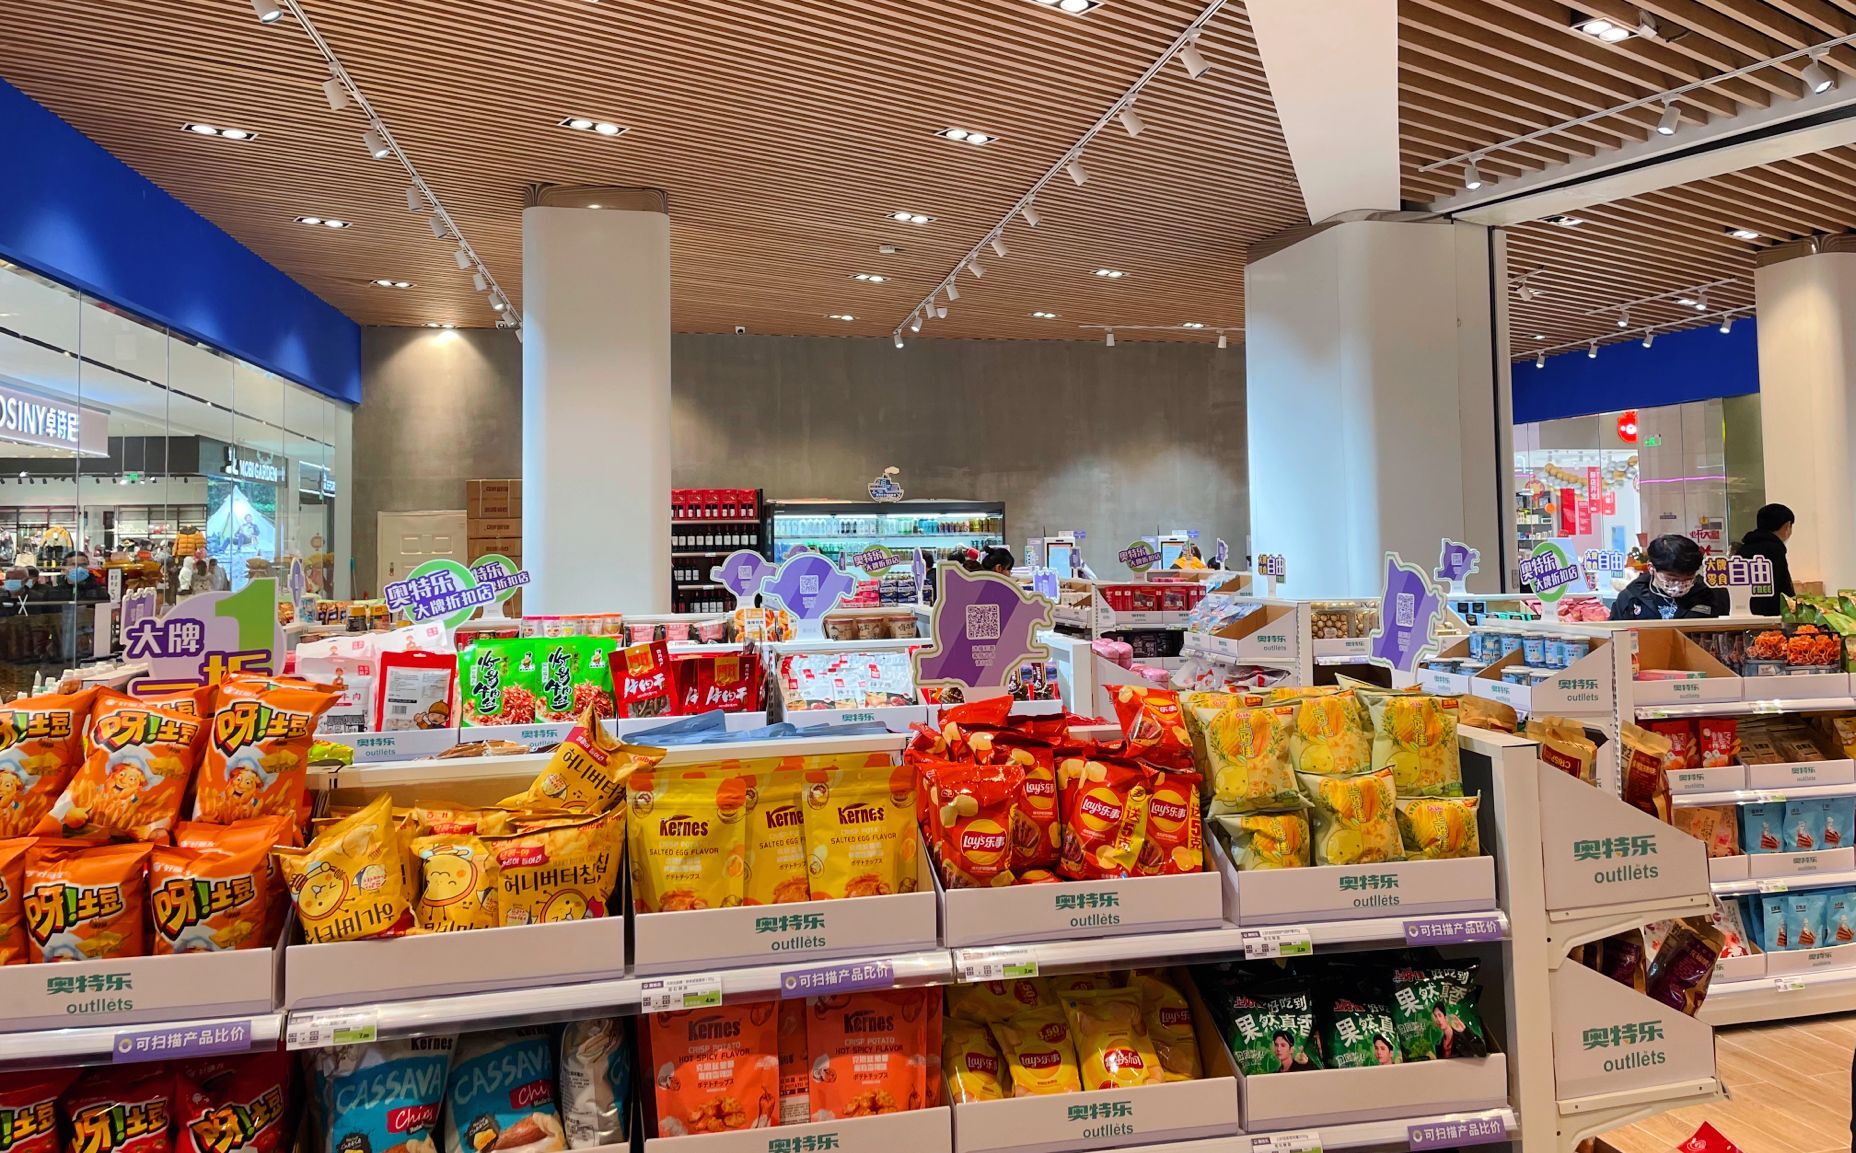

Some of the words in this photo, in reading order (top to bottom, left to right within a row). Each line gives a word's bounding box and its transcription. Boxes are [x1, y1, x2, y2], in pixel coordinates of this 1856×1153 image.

[854, 549, 884, 567] 奥特乐
[1119, 546, 1147, 562] 奥特乐
[1598, 551, 1623, 571] 自由
[472, 562, 504, 582] 特乐
[1521, 551, 1557, 582] 奥特乐
[1706, 559, 1727, 571] 大牌
[1728, 557, 1772, 585] 自由
[387, 570, 456, 607] 奥特乐
[1535, 566, 1578, 592] 大牌折扣店
[1707, 573, 1728, 586] 零食
[1753, 585, 1772, 594] FREE
[414, 584, 494, 621] 大牌折扣店
[131, 622, 200, 655] 大牌
[1257, 635, 1287, 643] 奥特乐
[1557, 679, 1599, 690] 奥特乐
[842, 712, 875, 722] 奥特乐
[97, 709, 200, 752] 呀!土豆
[213, 700, 313, 757] 呀!土豆
[522, 729, 558, 740] 奥特乐
[356, 738, 396, 748] 奥特乐
[765, 805, 805, 829] Kerne
[837, 803, 886, 825] Kernes
[660, 815, 709, 837] Kernes
[759, 839, 784, 850] SALTED
[785, 838, 799, 846] EGG
[830, 836, 856, 845] SALTED
[857, 834, 871, 842] EGG
[871, 832, 897, 842] FLAVOR
[1574, 835, 1659, 862] 奥特乐
[649, 848, 674, 856] SALTED
[690, 847, 720, 856] FLAVOR
[778, 861, 807, 871] ポテトチップ
[503, 863, 599, 896] 허니버터칩
[1339, 874, 1400, 891] 奥特乐
[152, 876, 256, 942] 呀!土豆
[1055, 892, 1120, 911] 奥特乐
[22, 879, 124, 947] 呀!土豆
[756, 912, 826, 934] 奥特乐
[1419, 920, 1497, 937] 可扫描产品比价
[46, 971, 133, 996] 奥特乐
[798, 966, 892, 988] 可扫描产品比价
[1394, 981, 1468, 1018] 果然真香
[688, 1017, 741, 1041] Kernes
[843, 1011, 894, 1034] Kernes
[1234, 1013, 1313, 1045] 果然真香
[1335, 1013, 1396, 1048] 果然真
[136, 1027, 246, 1052] 可扫描产品比价
[410, 1037, 453, 1051] Kernes
[844, 1038, 865, 1047] CRISP
[867, 1036, 895, 1045] POTATO
[1582, 1020, 1665, 1050] 奥特乐
[679, 1055, 694, 1063] HOT
[696, 1053, 718, 1062] SPICY
[721, 1048, 751, 1060] FLAVOR
[688, 1045, 711, 1054] CRISP
[712, 1041, 741, 1050] POTATO
[835, 1047, 850, 1055] HOT
[852, 1045, 873, 1054] SPICY
[875, 1044, 904, 1053] FLAVOR
[335, 1063, 441, 1115] CASSAVA
[517, 1079, 549, 1106] Chi
[1067, 1101, 1133, 1122] 奥特乐
[768, 1133, 840, 1153] 奥特乐
[1424, 1122, 1501, 1142] 可扫描产品比价
